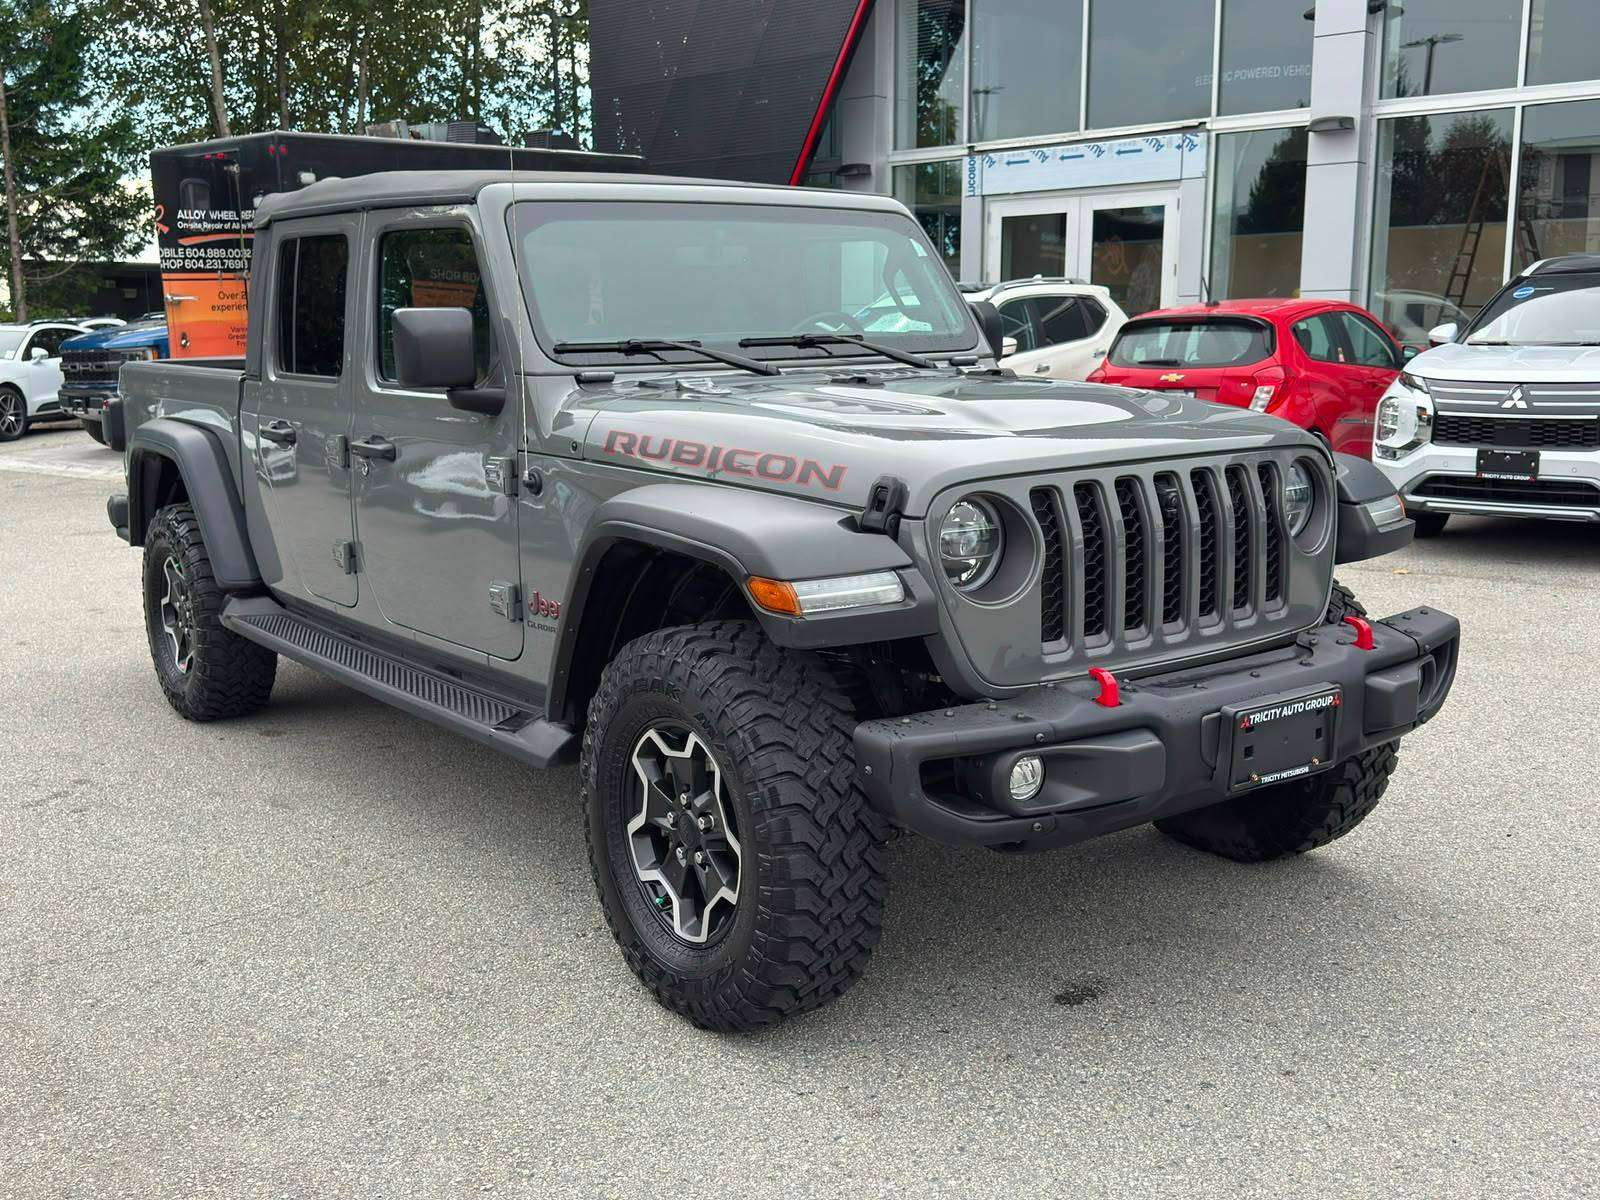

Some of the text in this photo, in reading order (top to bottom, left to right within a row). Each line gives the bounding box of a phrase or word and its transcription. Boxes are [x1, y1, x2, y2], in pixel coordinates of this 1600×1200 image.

[1234, 66, 1280, 80] POWERED
[177, 209, 207, 220] ALLOY
[209, 210, 239, 220] WHEEL
[218, 290, 239, 300] Over
[602, 429, 848, 492] RUBICON
[1250, 695, 1334, 725] TRICITY AUTO GROUP
[1261, 766, 1309, 784] TRICITY MITSUBISHI
